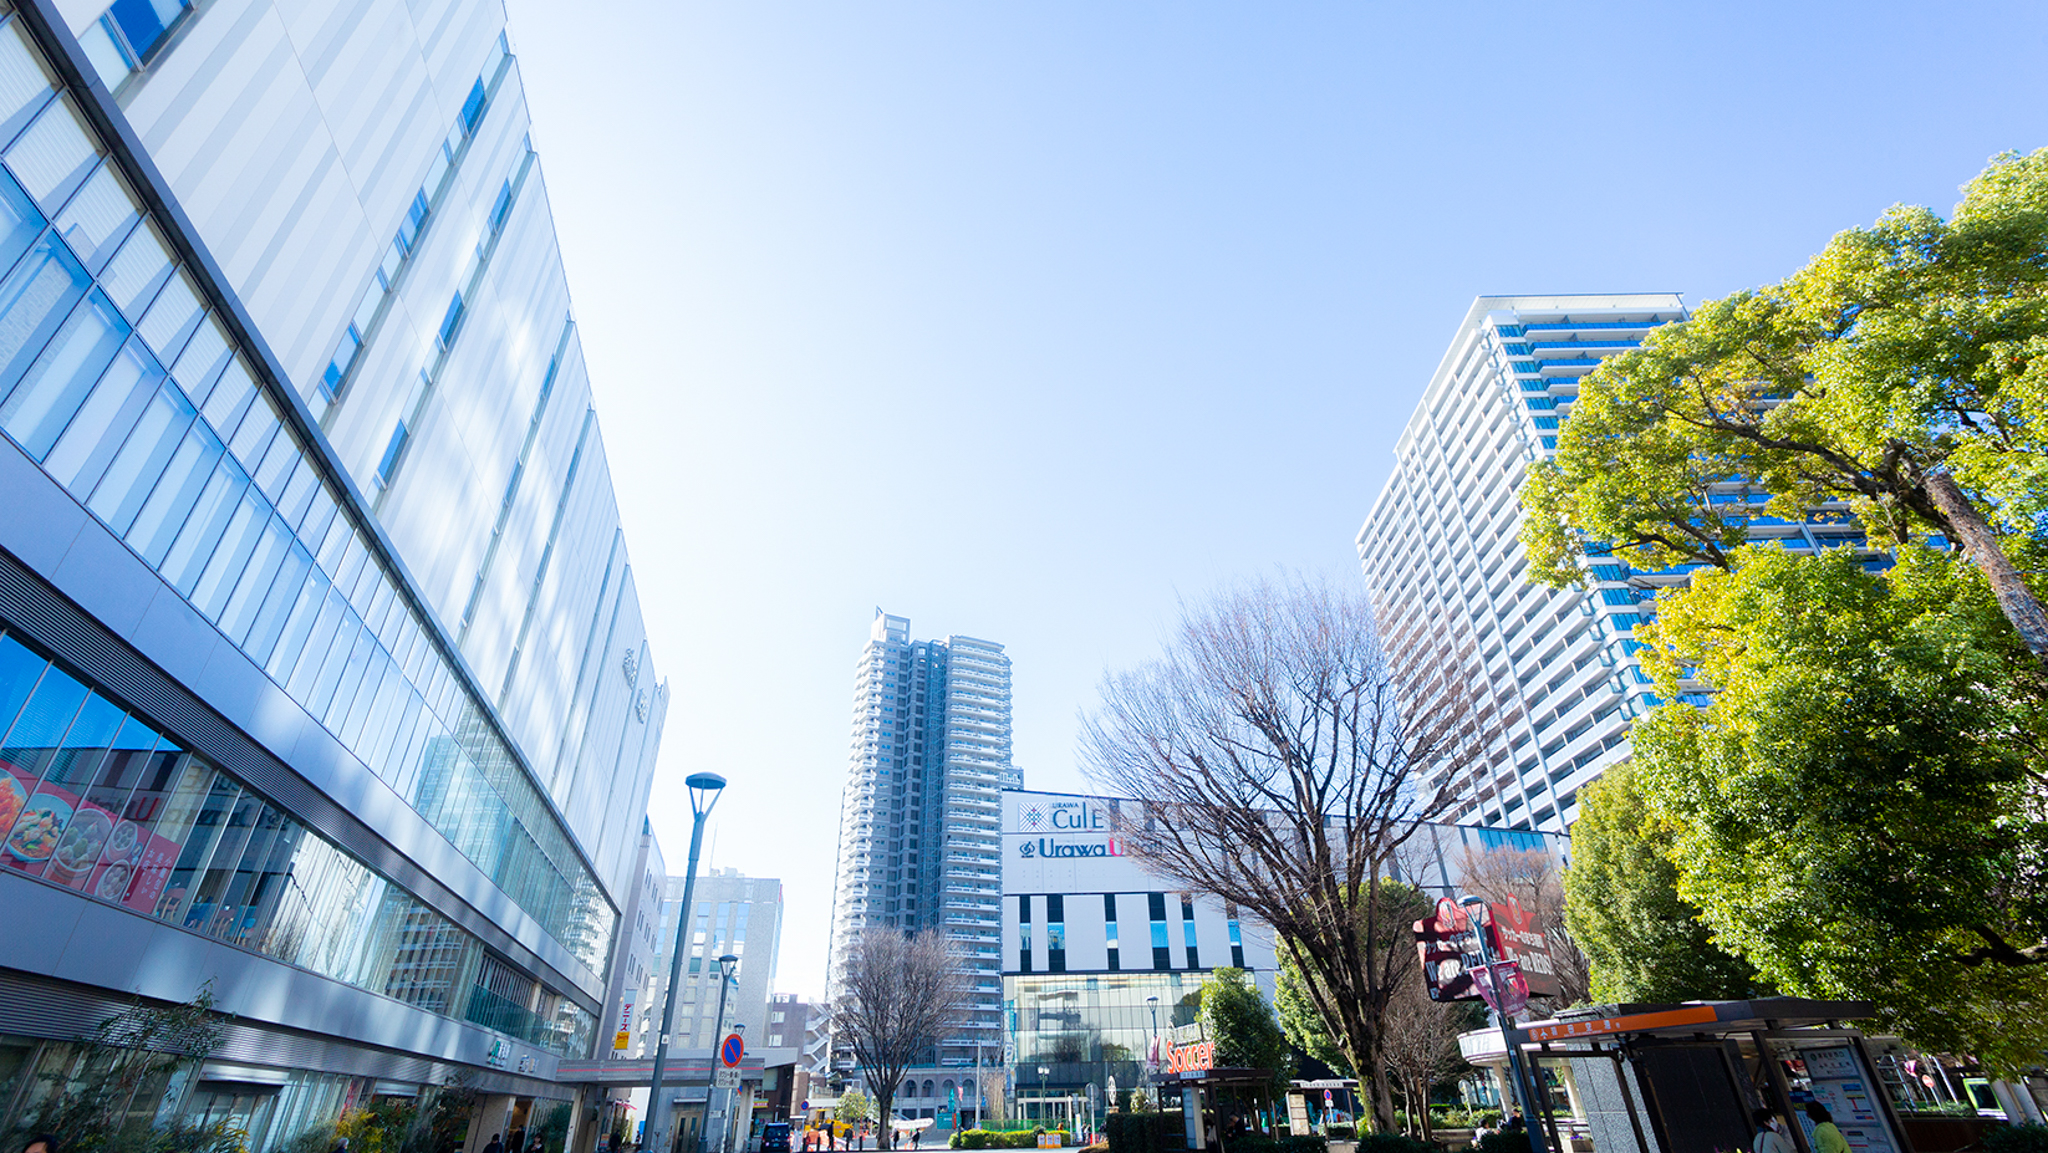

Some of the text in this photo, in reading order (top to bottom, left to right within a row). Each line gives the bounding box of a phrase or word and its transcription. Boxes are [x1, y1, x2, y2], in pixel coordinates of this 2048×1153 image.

[620, 1003, 634, 1031] デニーズ
[1166, 1040, 1214, 1075] Soccer
